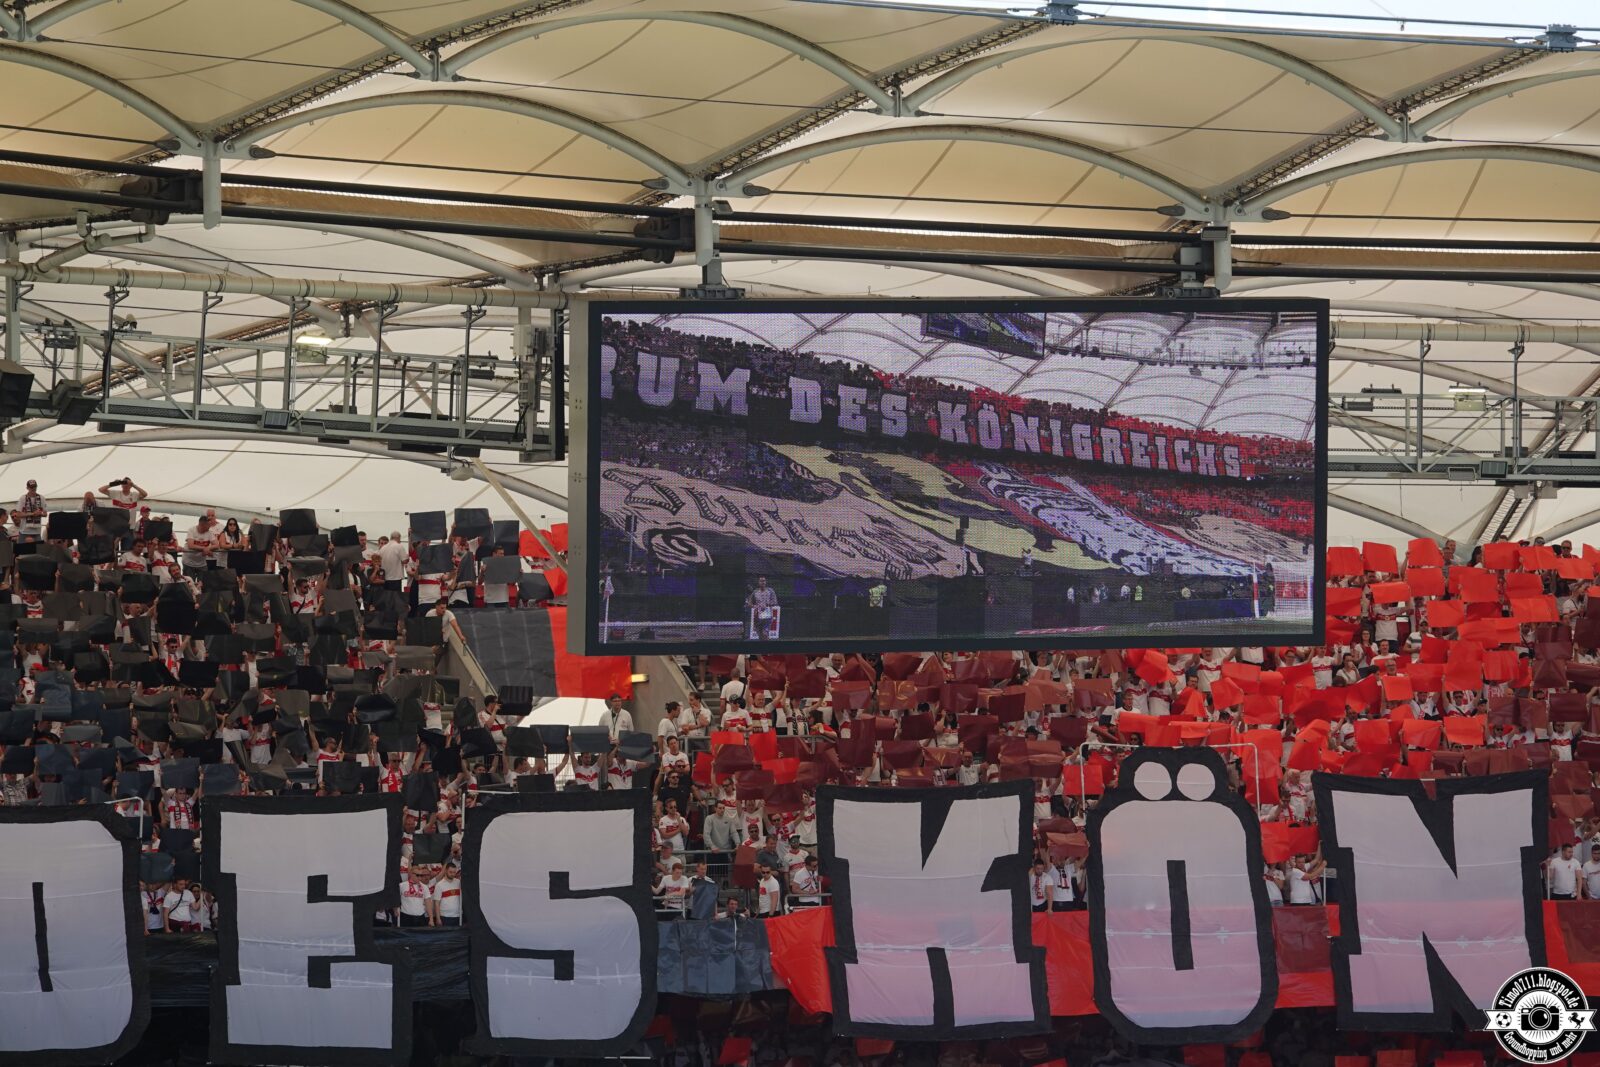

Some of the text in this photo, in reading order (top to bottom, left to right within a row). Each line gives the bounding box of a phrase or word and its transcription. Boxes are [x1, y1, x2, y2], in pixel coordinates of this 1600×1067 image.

[789, 375, 908, 437] DES
[938, 400, 1242, 478] KÖNIGREICHS
[0, 760, 1536, 1052] DES KÖN
